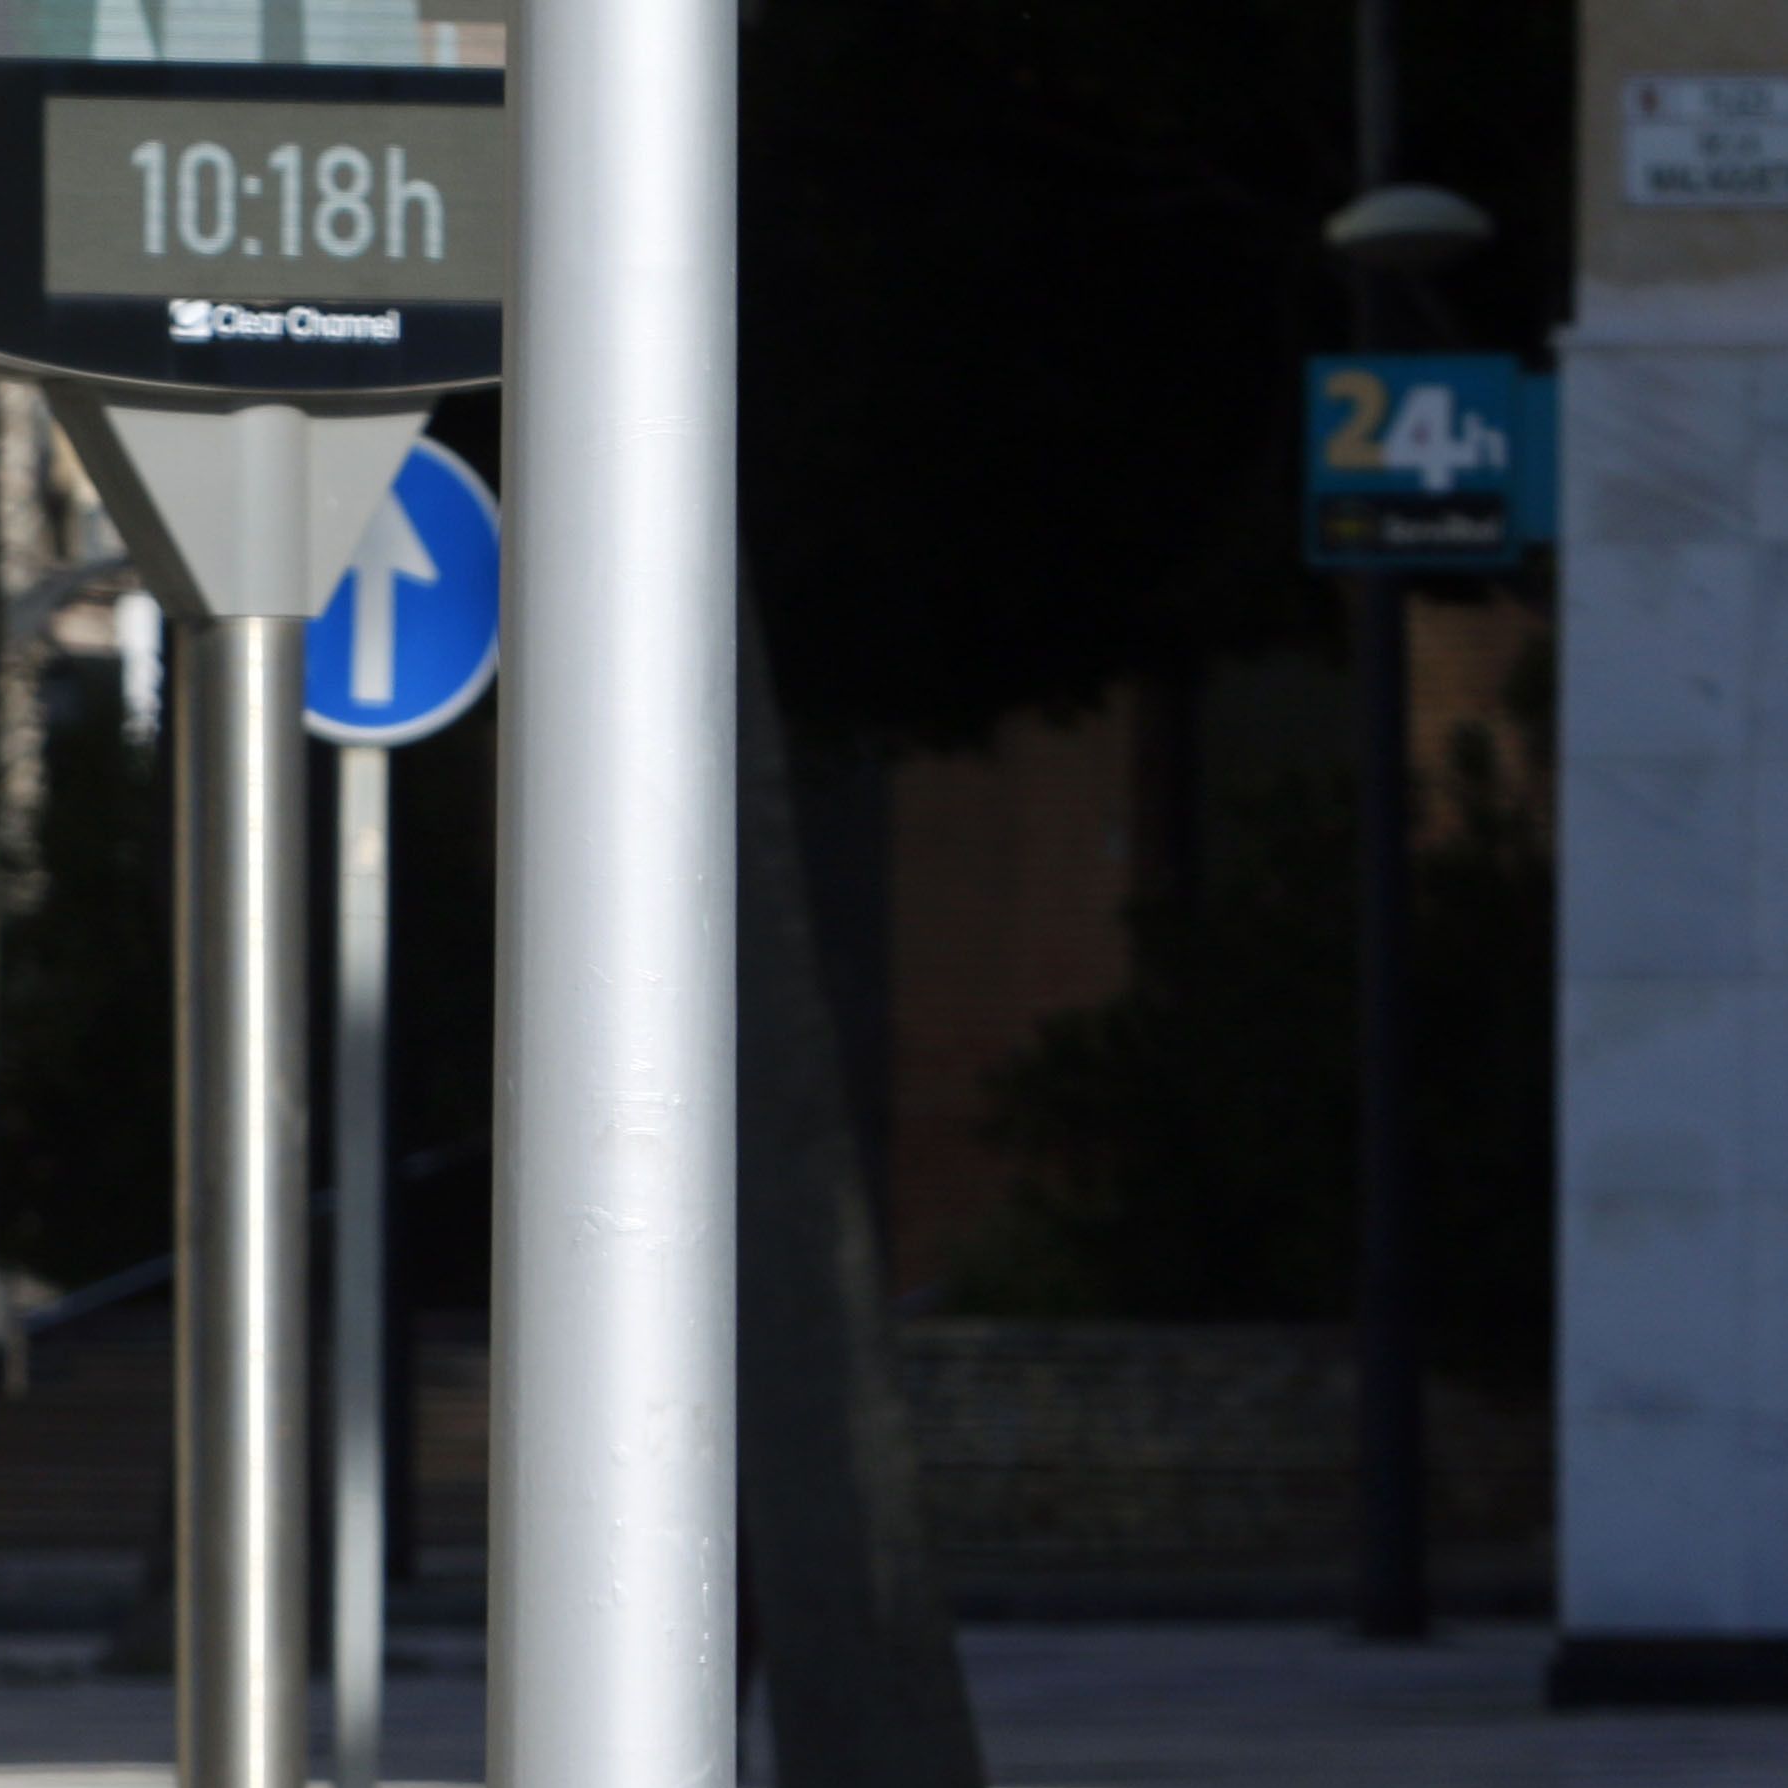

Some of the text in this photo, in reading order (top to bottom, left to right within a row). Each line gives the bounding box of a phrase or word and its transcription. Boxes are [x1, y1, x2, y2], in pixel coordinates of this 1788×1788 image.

[130, 138, 445, 262] 10:18h
[212, 303, 401, 344] Clear Channel
[1324, 370, 1511, 494] 24h
